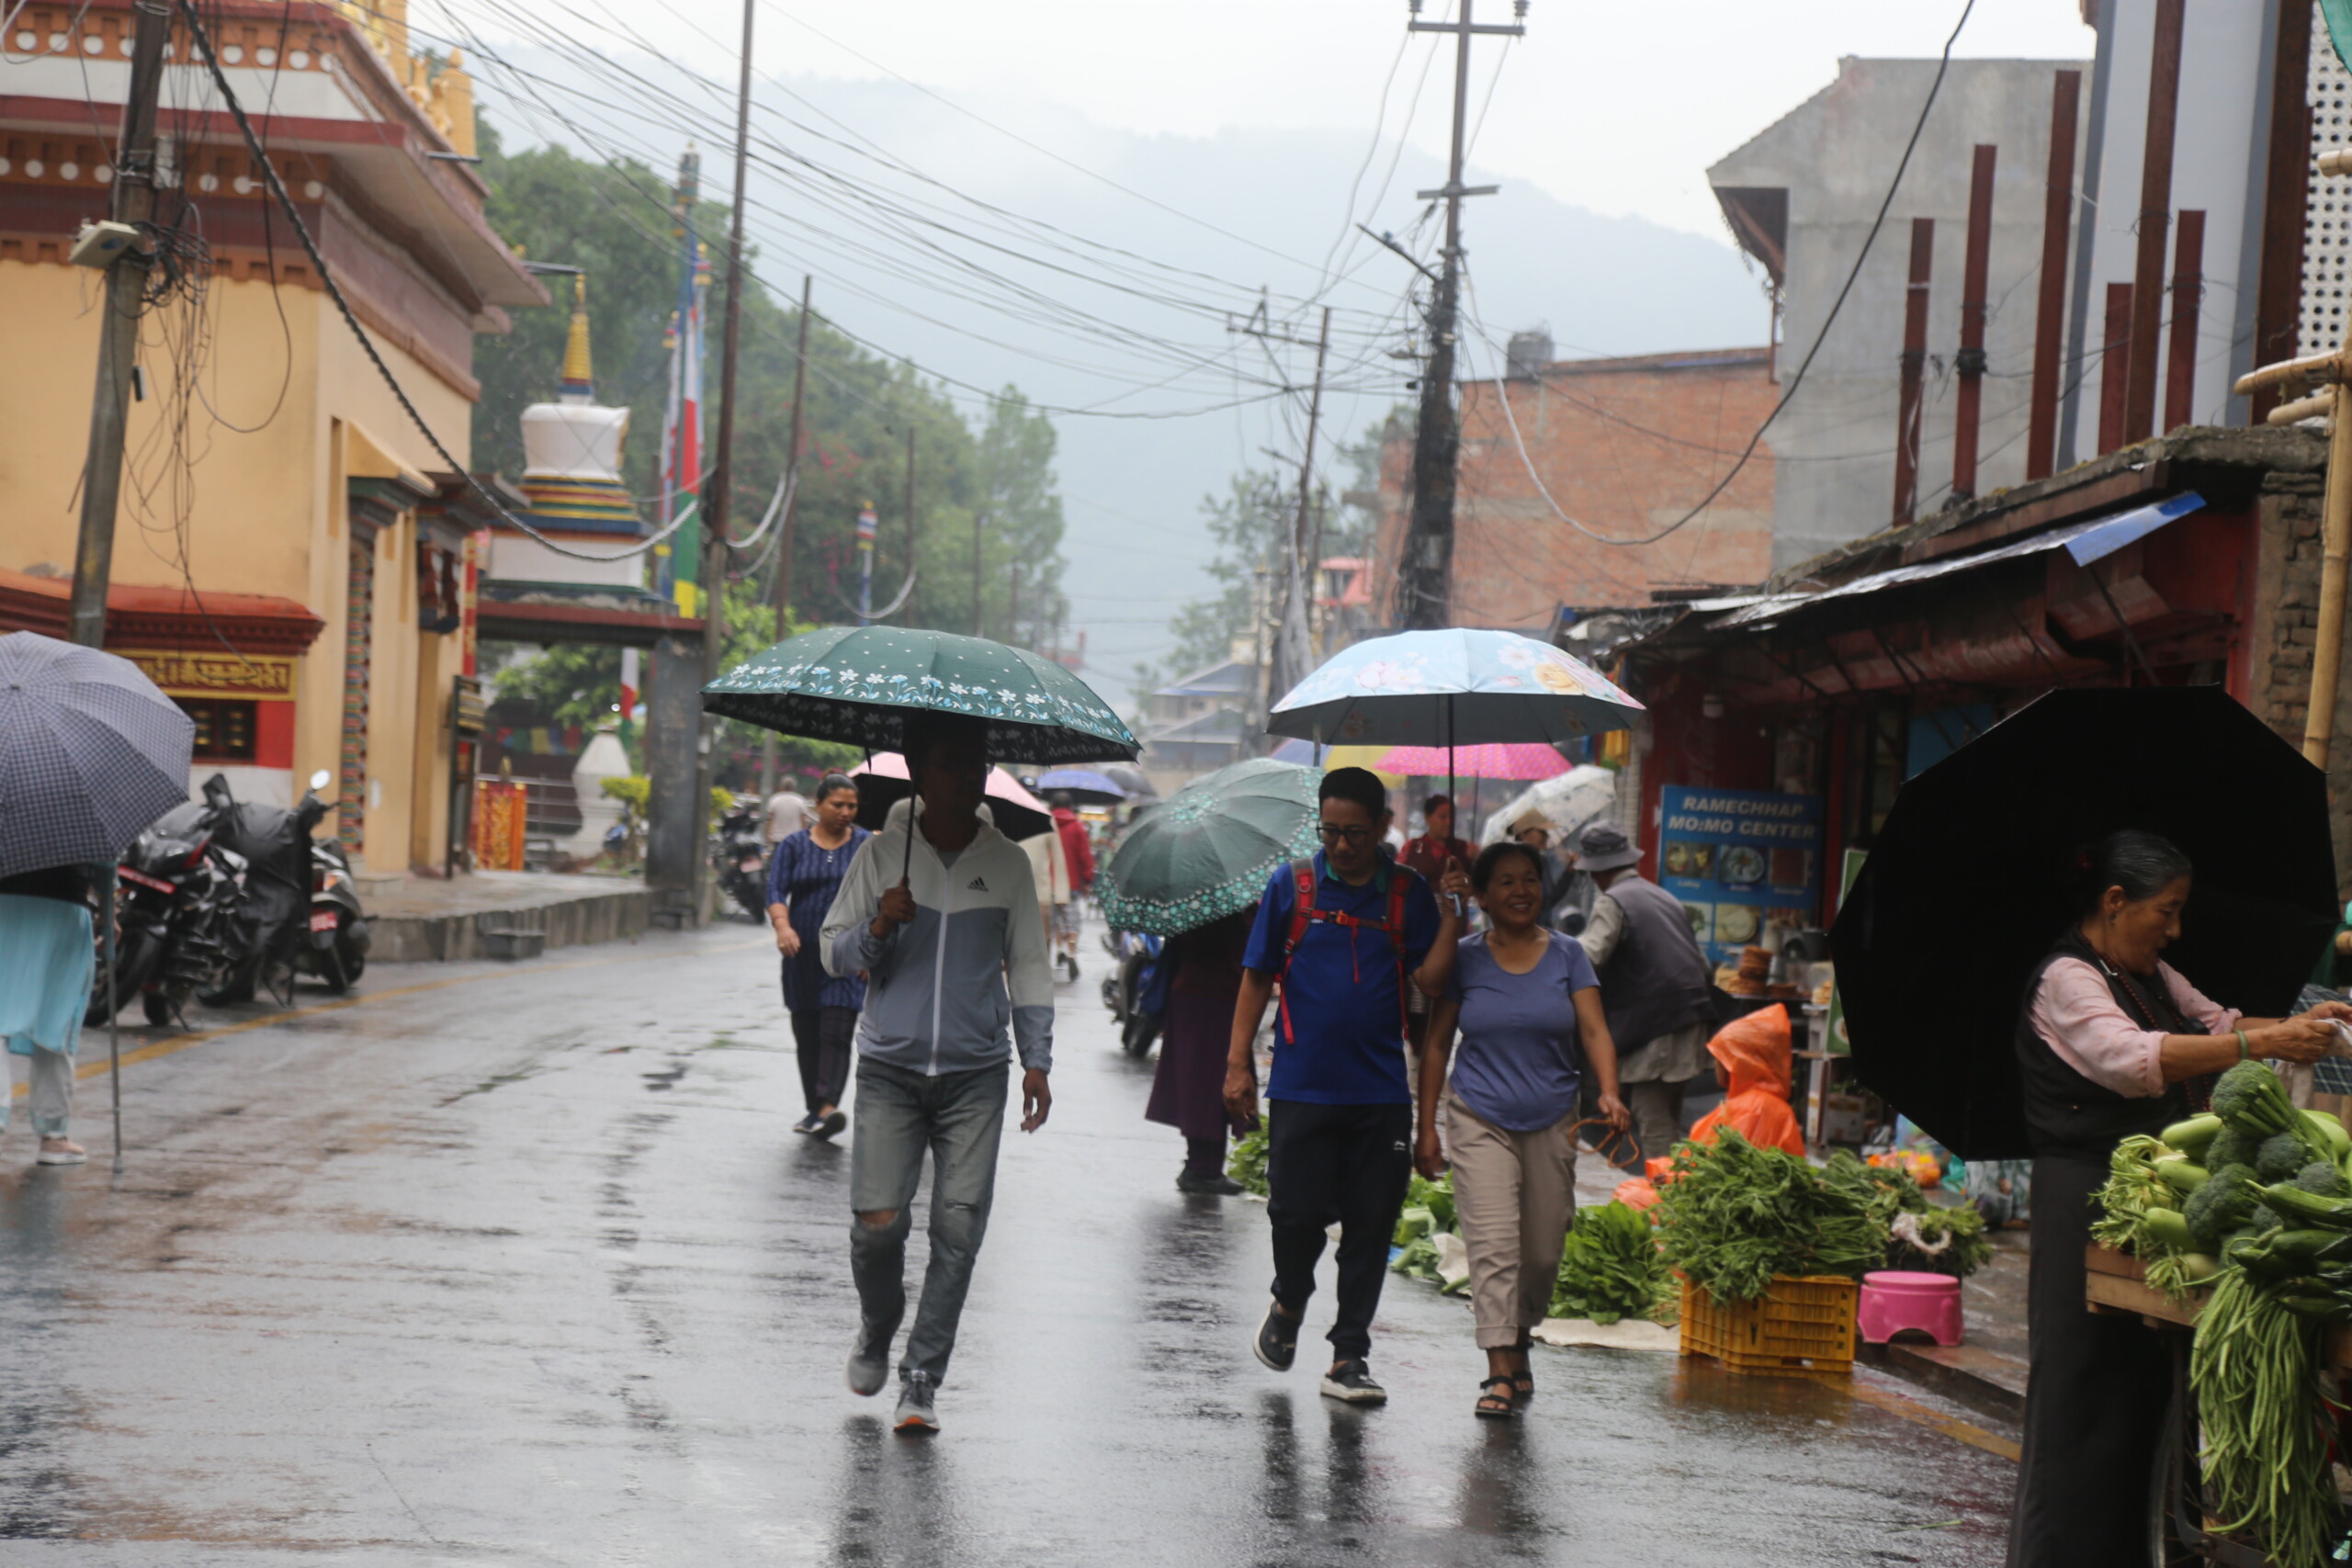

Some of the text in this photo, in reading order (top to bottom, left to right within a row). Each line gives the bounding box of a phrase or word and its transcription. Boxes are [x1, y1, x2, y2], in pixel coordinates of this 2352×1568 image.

[1683, 796, 1804, 818] RAMECHHAP
[1668, 815, 1815, 839] MO:MO CENTER
